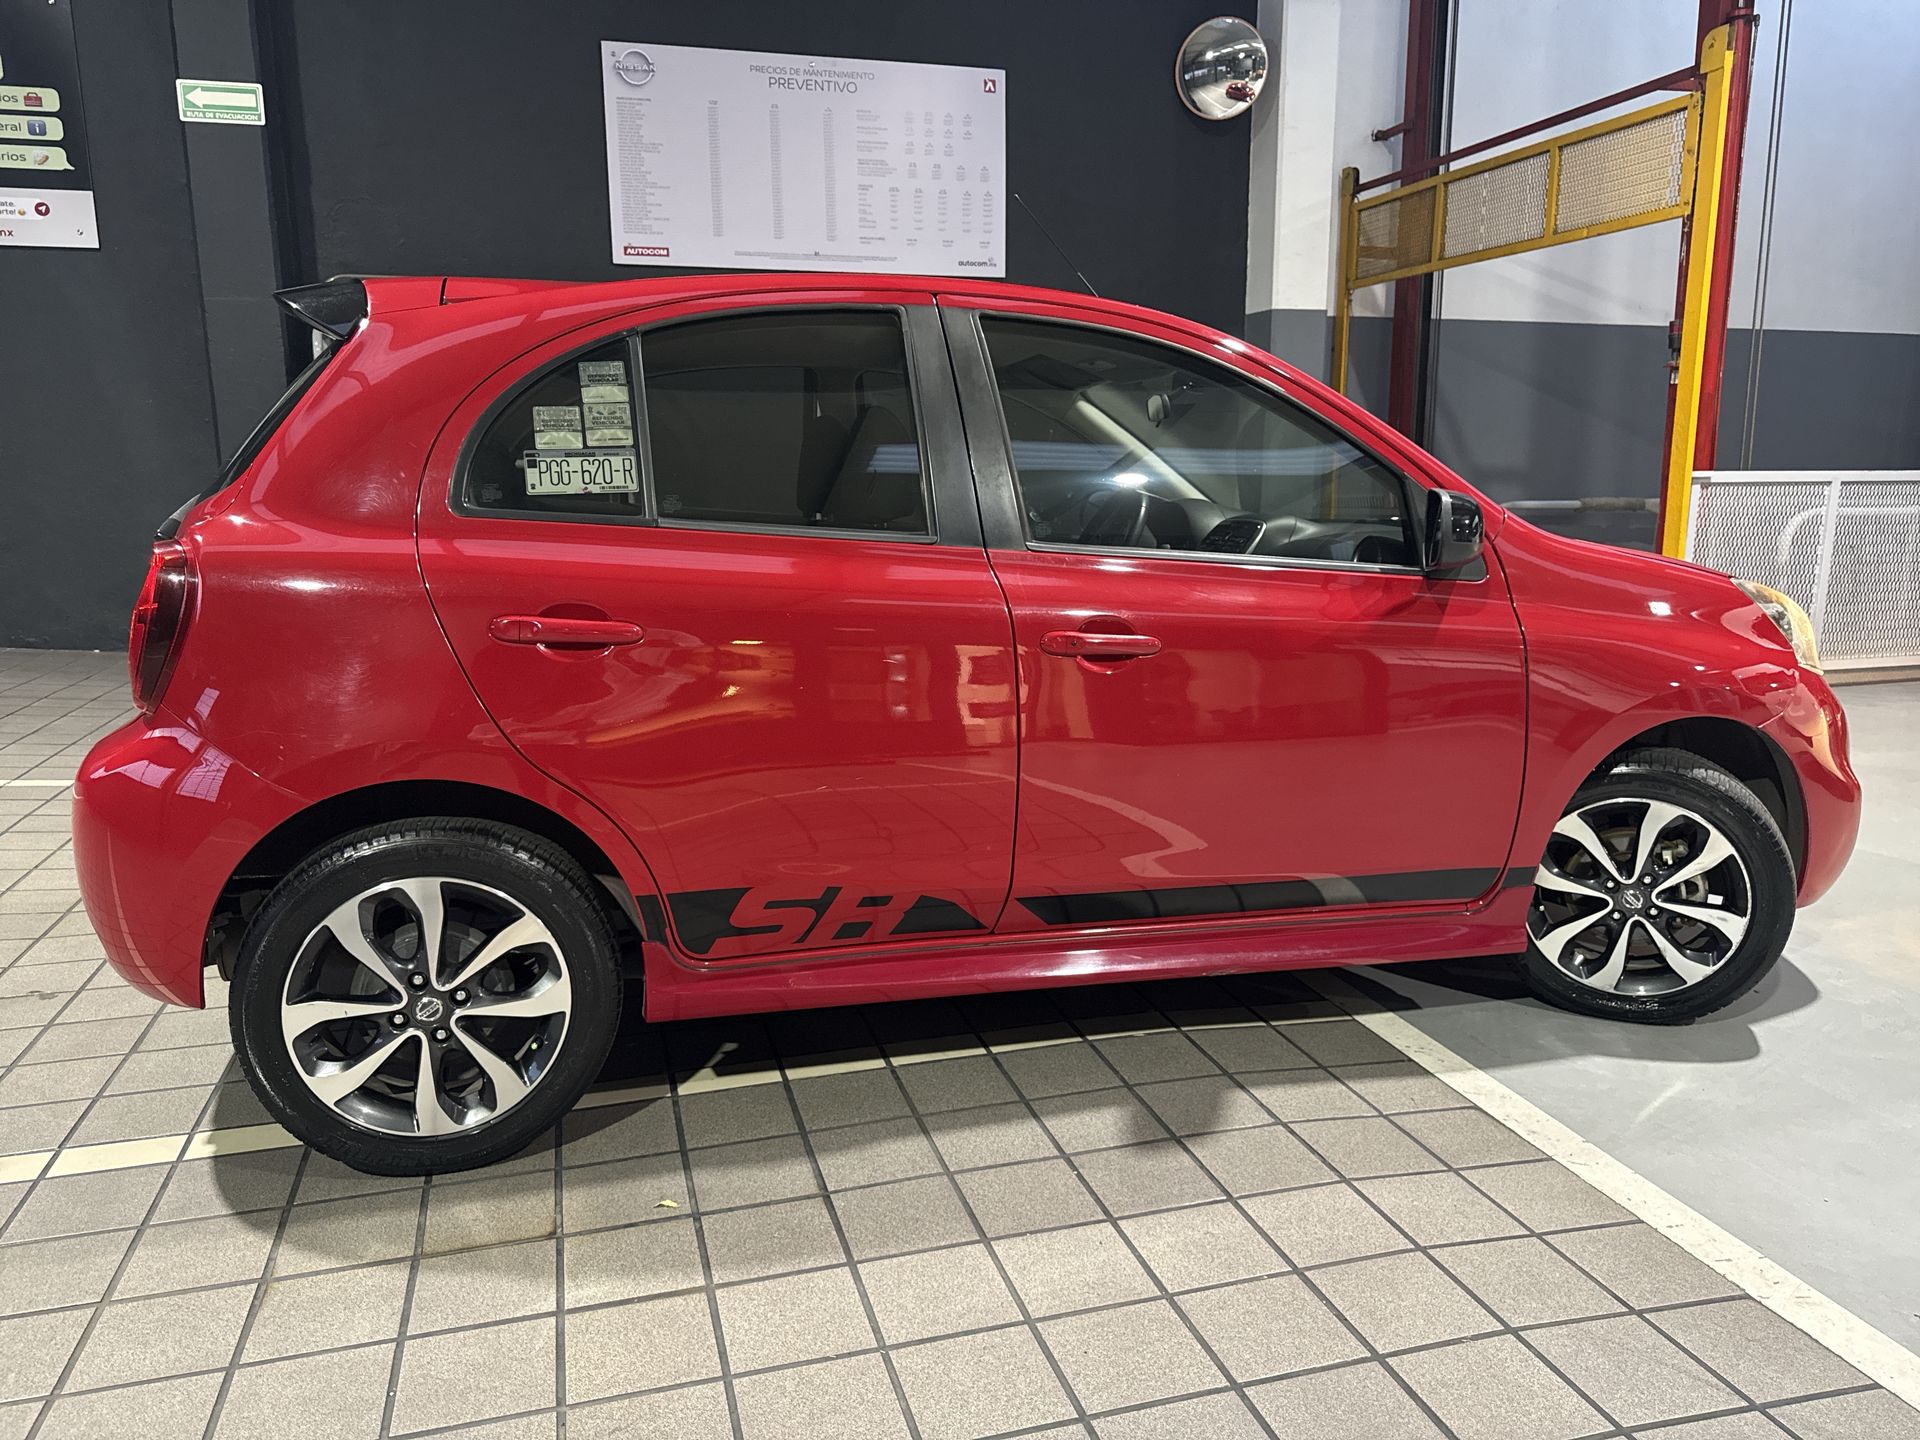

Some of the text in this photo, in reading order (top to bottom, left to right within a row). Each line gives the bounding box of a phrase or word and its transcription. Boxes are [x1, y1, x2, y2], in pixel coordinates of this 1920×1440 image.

[615, 62, 656, 72] NISSAN
[749, 64, 875, 80] PRECIOS DE MANTENIMIENTO
[768, 76, 858, 94] PREVENTIVO
[626, 247, 668, 256] AUTOCOM
[538, 458, 634, 486] PGG-620-R
